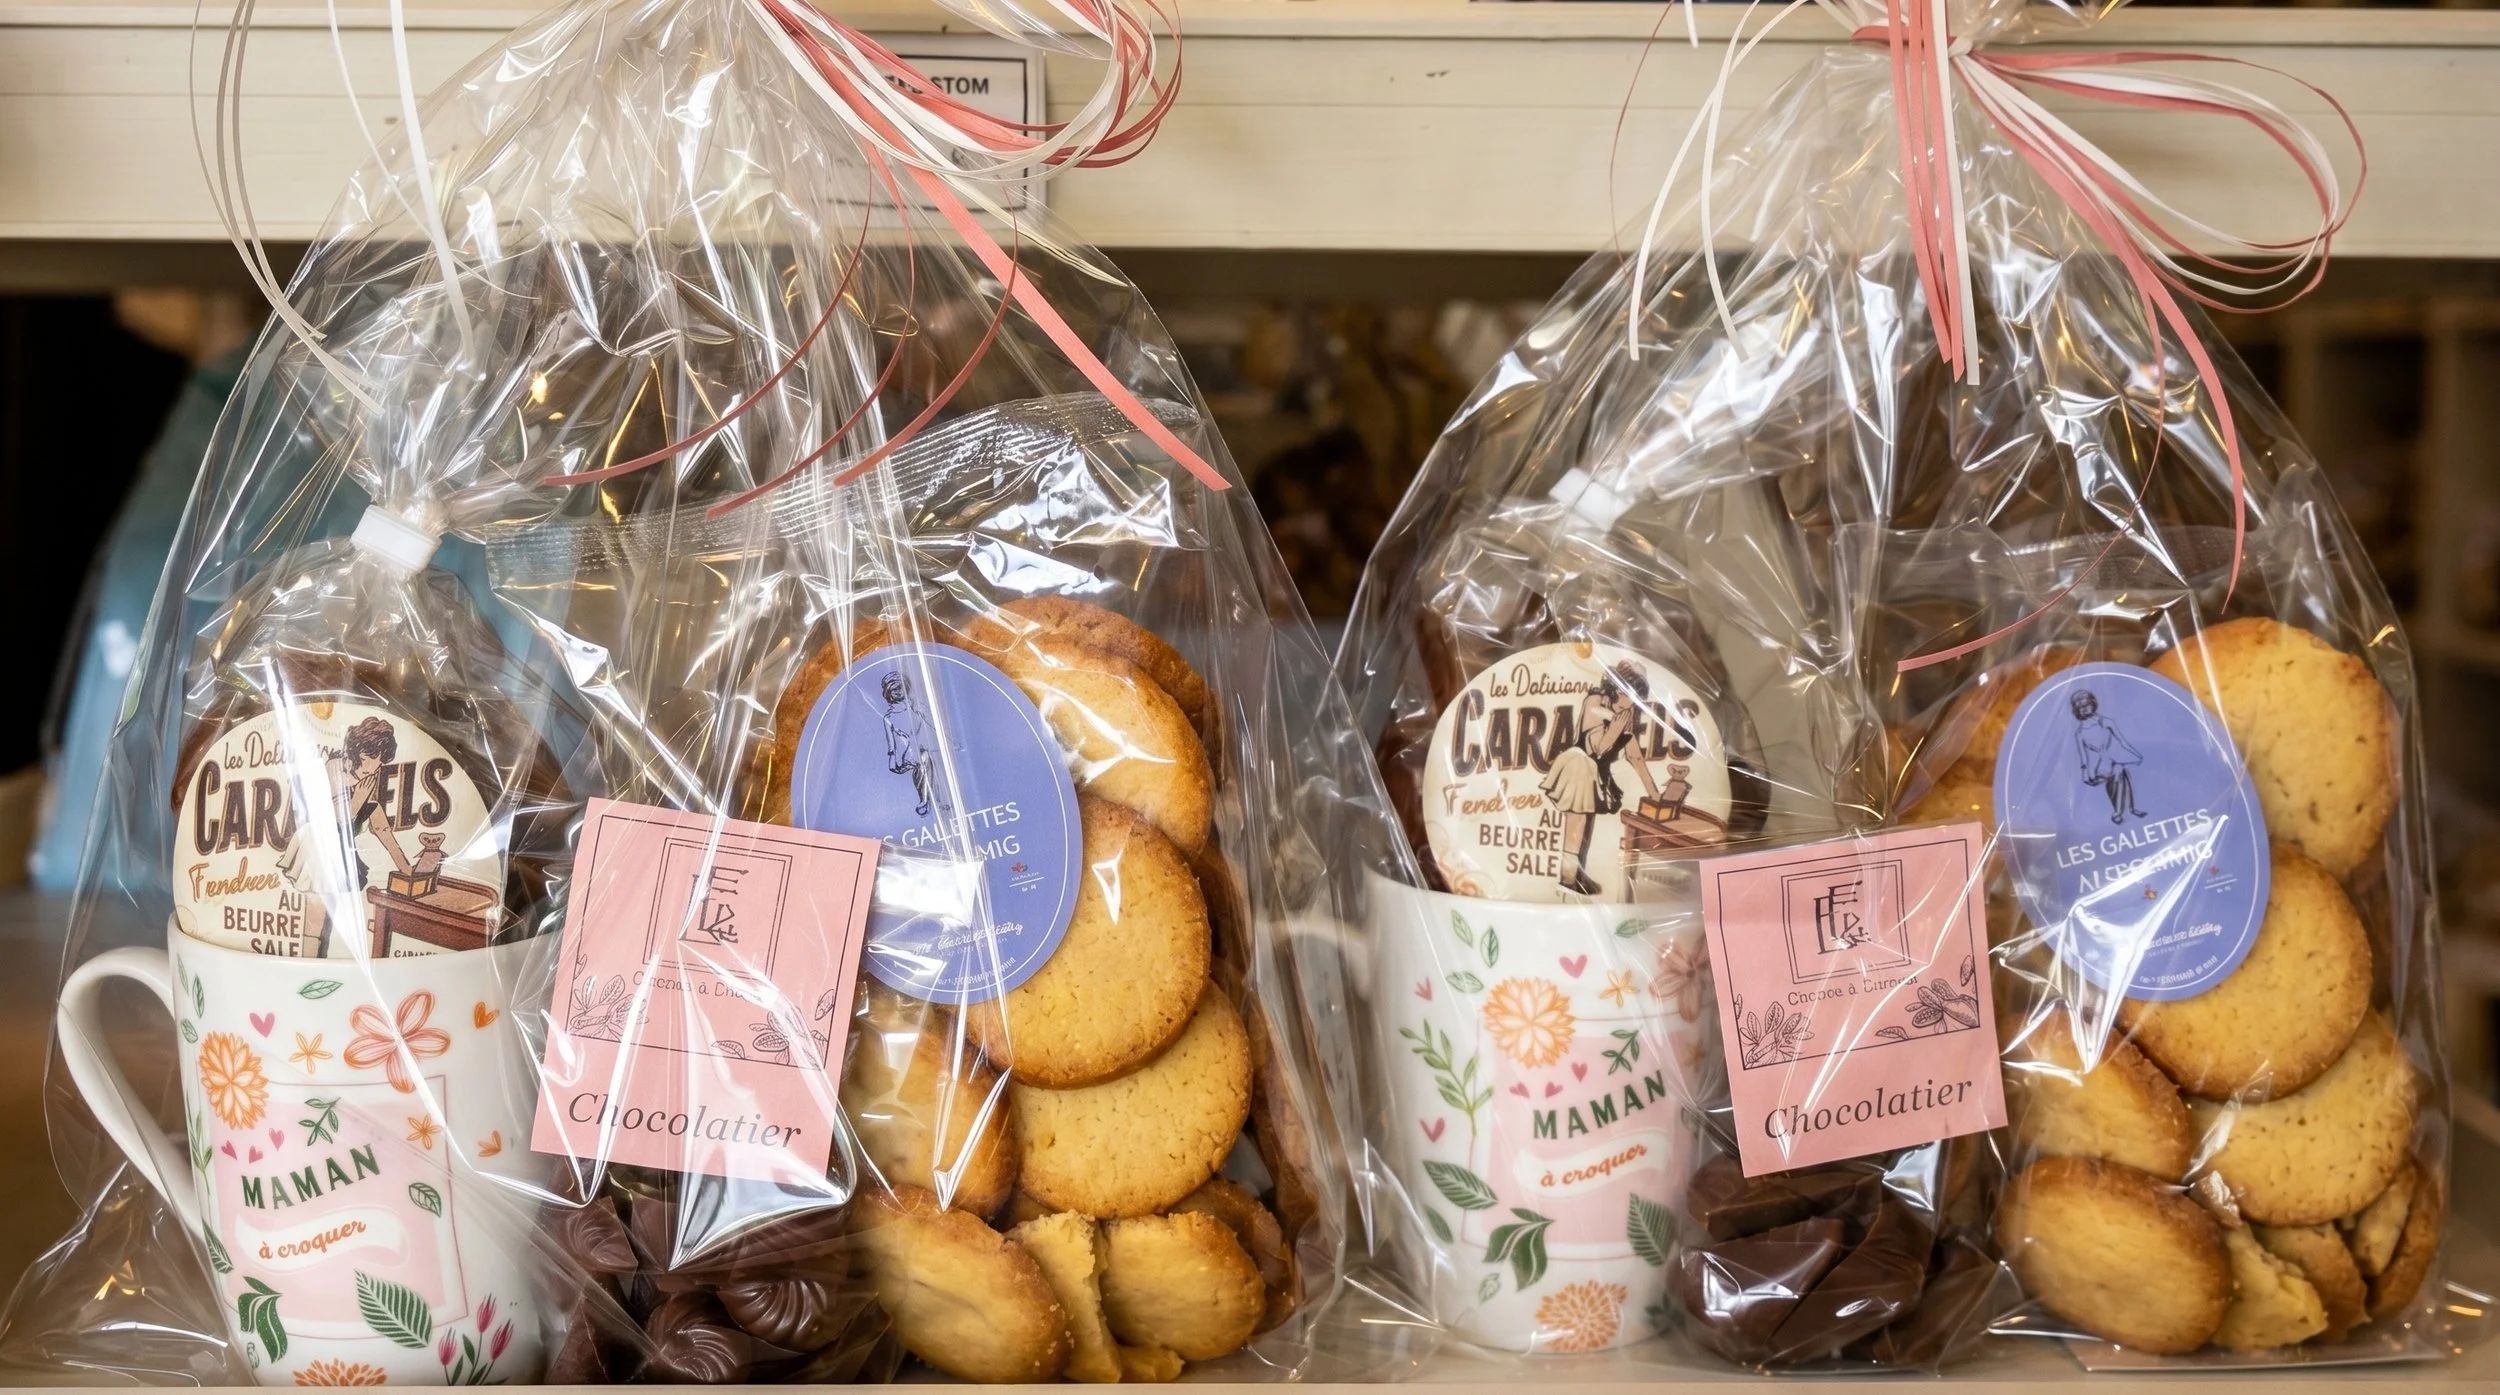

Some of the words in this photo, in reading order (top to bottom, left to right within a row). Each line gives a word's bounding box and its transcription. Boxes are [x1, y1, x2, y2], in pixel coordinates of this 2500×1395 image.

[1450, 688, 1700, 777] CARAELS
[194, 757, 453, 856] CARELS
[902, 801, 1021, 848] GALETTES
[1539, 808, 1562, 828] AU
[1479, 823, 1561, 852] BEURRE
[2056, 842, 2096, 868] LES
[2100, 808, 2212, 855] GALETTES
[1506, 852, 1559, 877] SALE
[224, 906, 301, 938] BEURRE
[279, 890, 302, 912] AU
[568, 1092, 802, 1148] Chocolatier
[1533, 1070, 1666, 1140] MAMAN
[1764, 1078, 1973, 1139] Chocolatier
[241, 1143, 382, 1210] MAMAN
[1540, 1169, 1554, 1187] à
[1562, 1141, 1648, 1187] croquer
[258, 1240, 273, 1260] à
[277, 1220, 367, 1259] croquer
